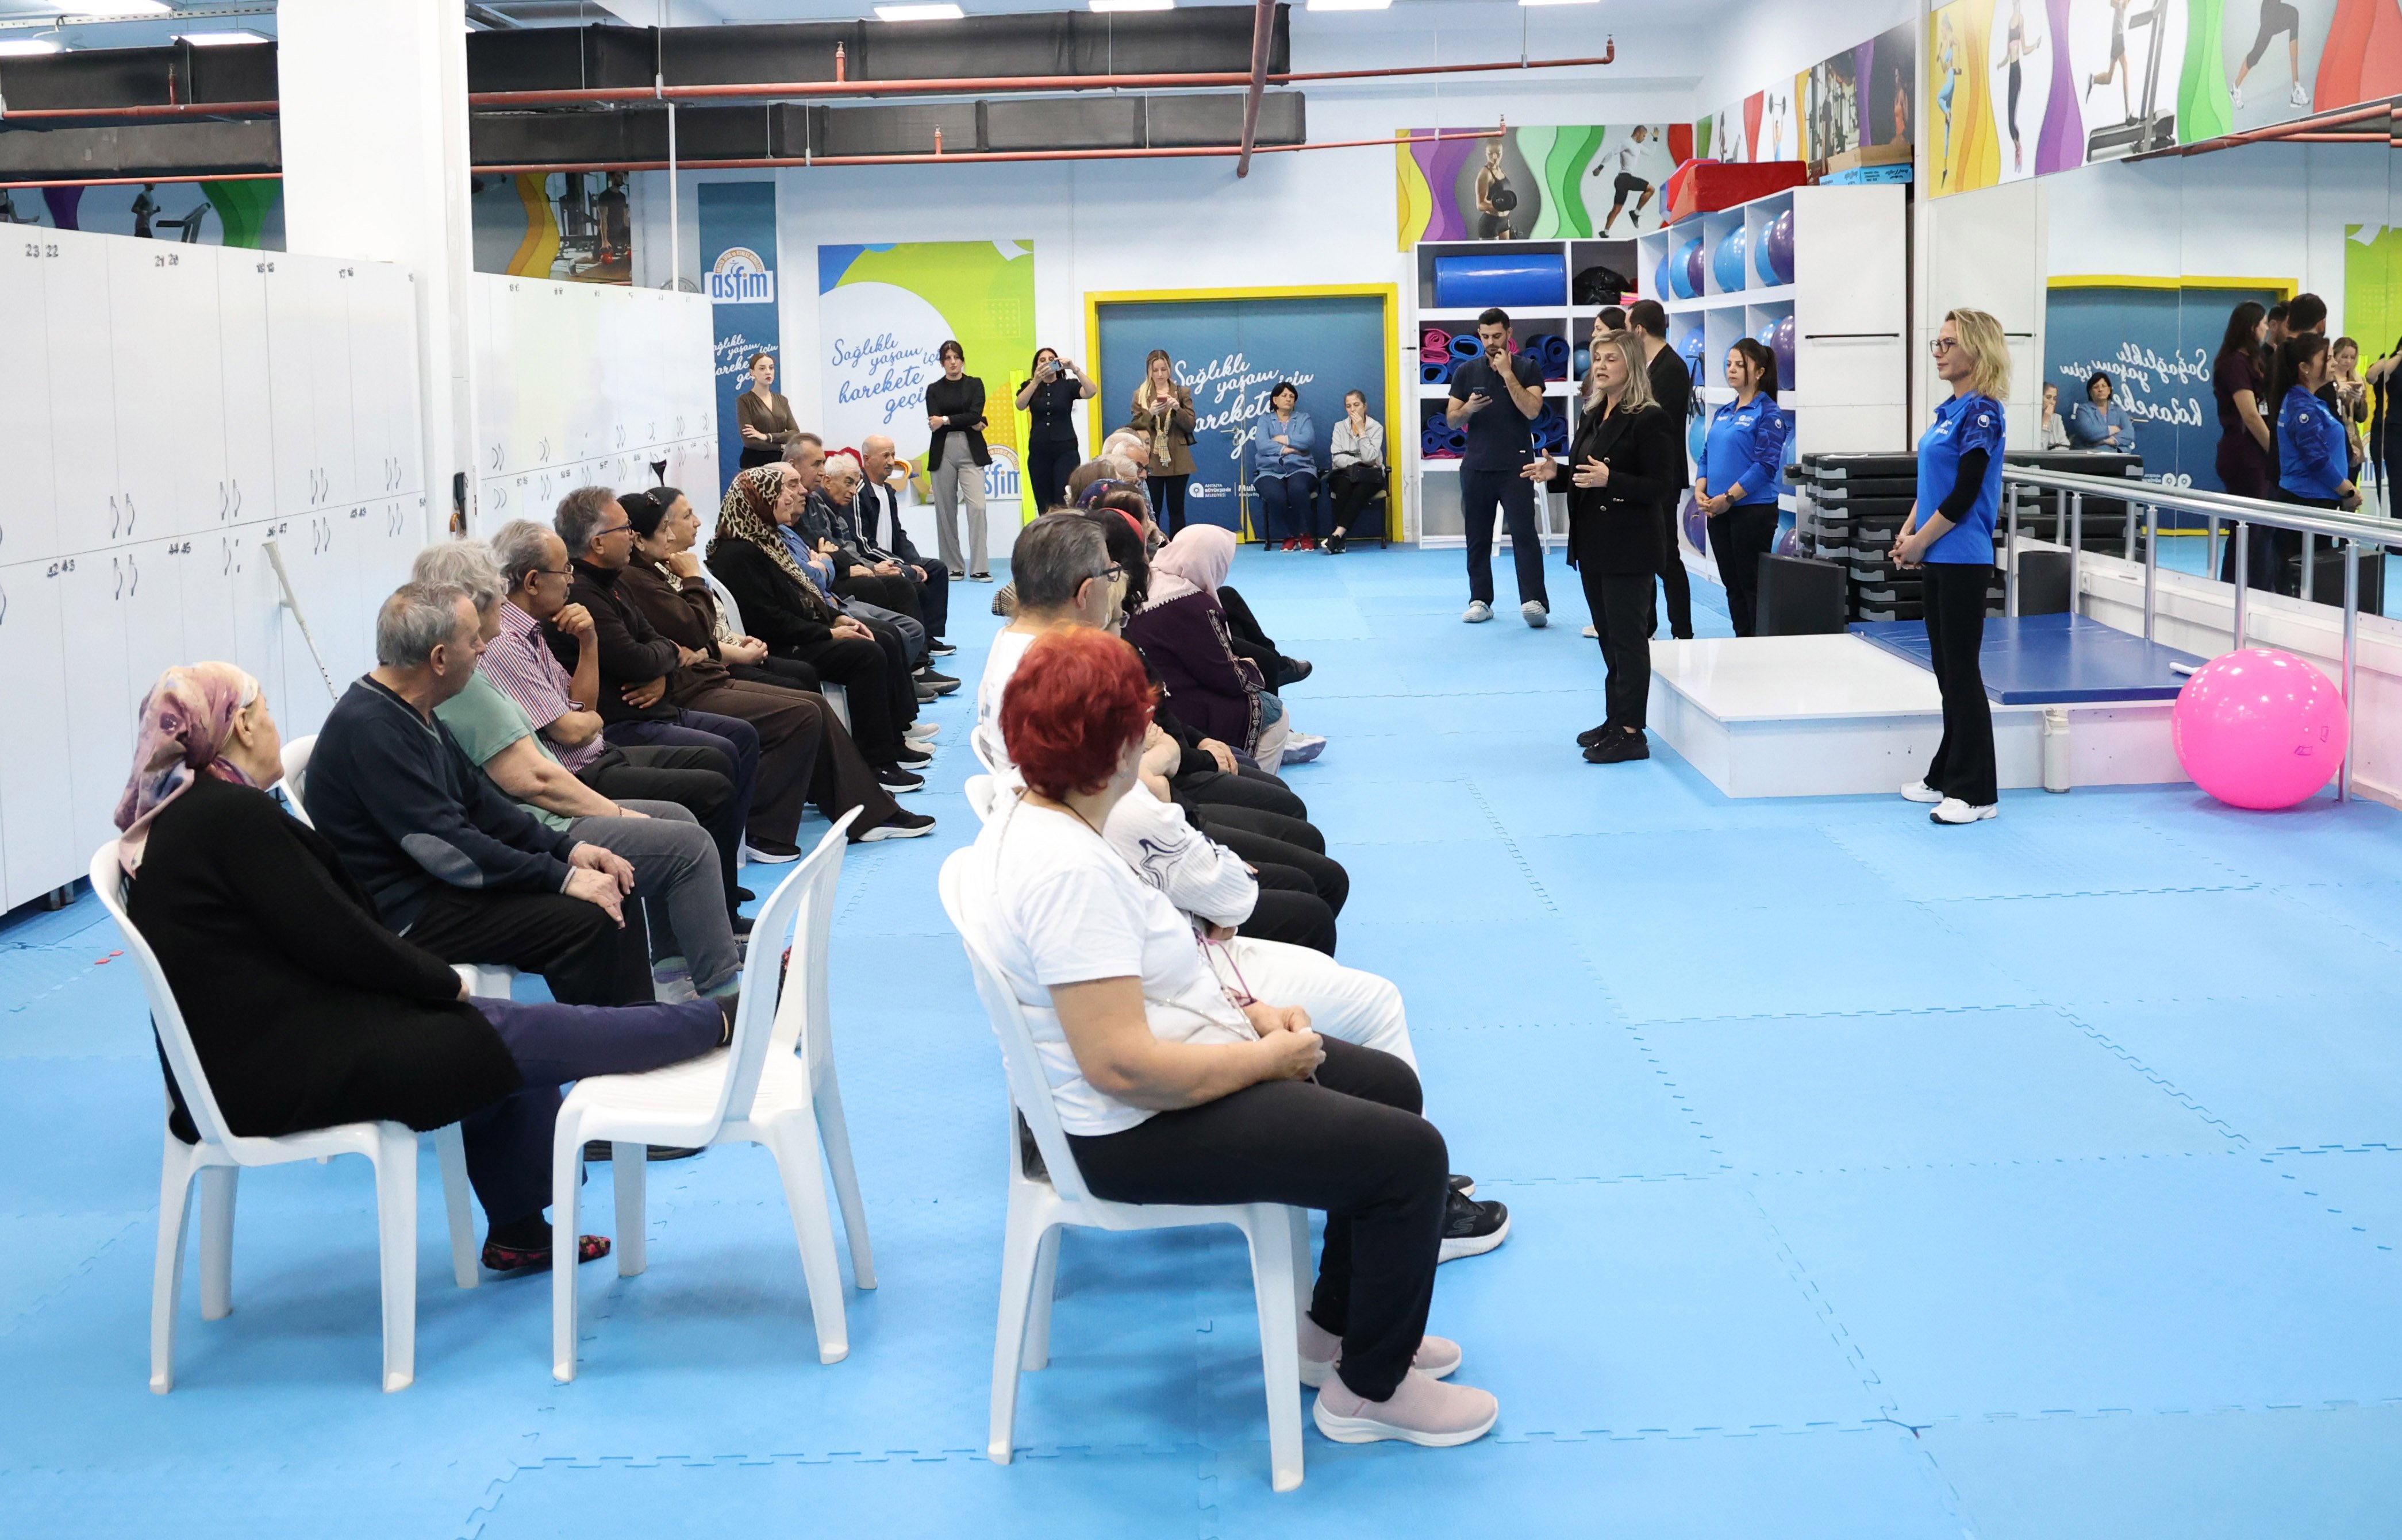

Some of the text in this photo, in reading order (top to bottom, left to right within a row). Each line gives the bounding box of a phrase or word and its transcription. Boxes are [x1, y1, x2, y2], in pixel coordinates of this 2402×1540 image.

[25, 243, 40, 259] 23
[45, 244, 59, 258] 22
[154, 255, 165, 267] 21
[712, 266, 768, 302] asfim
[713, 334, 746, 356] ağlıklı
[832, 332, 899, 368] Sağlıklı
[868, 347, 940, 376] yaşam içi
[839, 365, 924, 404] harekete
[1174, 352, 1251, 395] Sağlıklı
[1214, 369, 1279, 404] yaşam
[883, 386, 927, 425] geçi
[1193, 390, 1275, 433] areket
[985, 463, 1020, 499] sfim
[1238, 483, 1256, 492] Muh
[61, 559, 75, 572] 43
